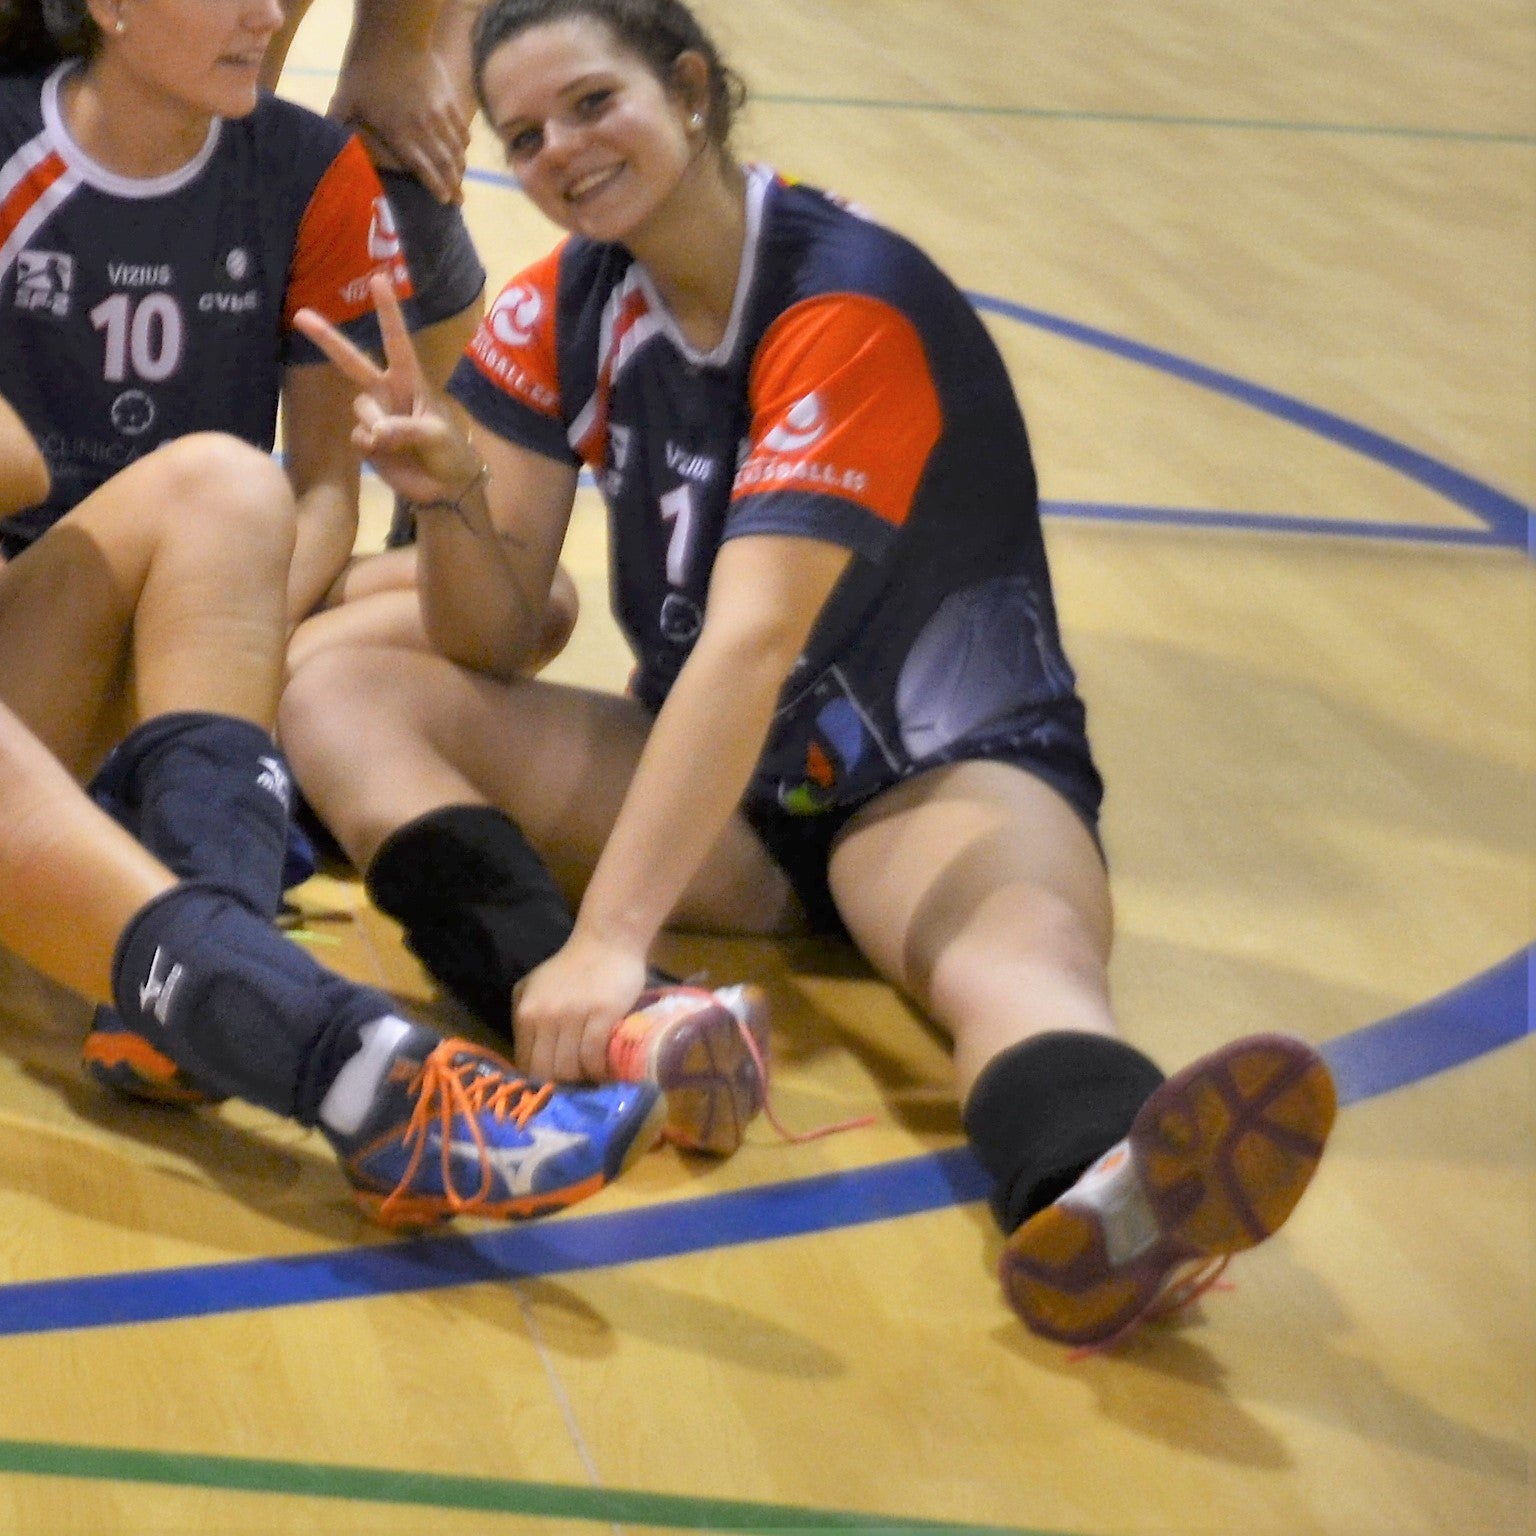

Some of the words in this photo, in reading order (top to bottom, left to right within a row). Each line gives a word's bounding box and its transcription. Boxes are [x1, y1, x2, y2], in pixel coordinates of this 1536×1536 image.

[107, 262, 172, 286] VIZIUS
[89, 290, 184, 383] 10
[658, 482, 692, 586] 1
